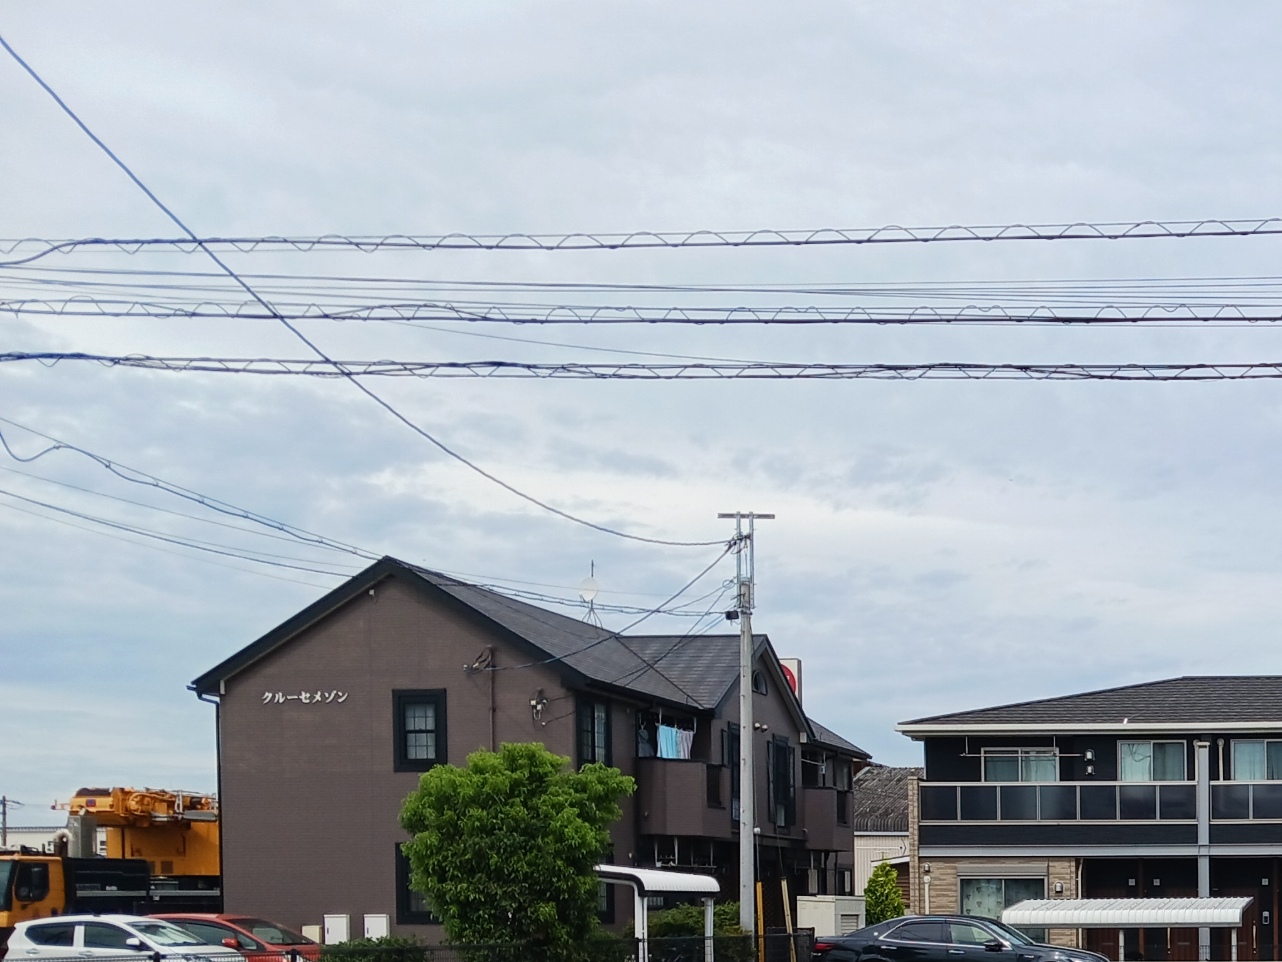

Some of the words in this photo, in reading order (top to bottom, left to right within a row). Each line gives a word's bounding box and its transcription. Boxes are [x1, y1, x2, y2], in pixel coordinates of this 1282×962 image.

[261, 690, 348, 704] クルーセメゾン
